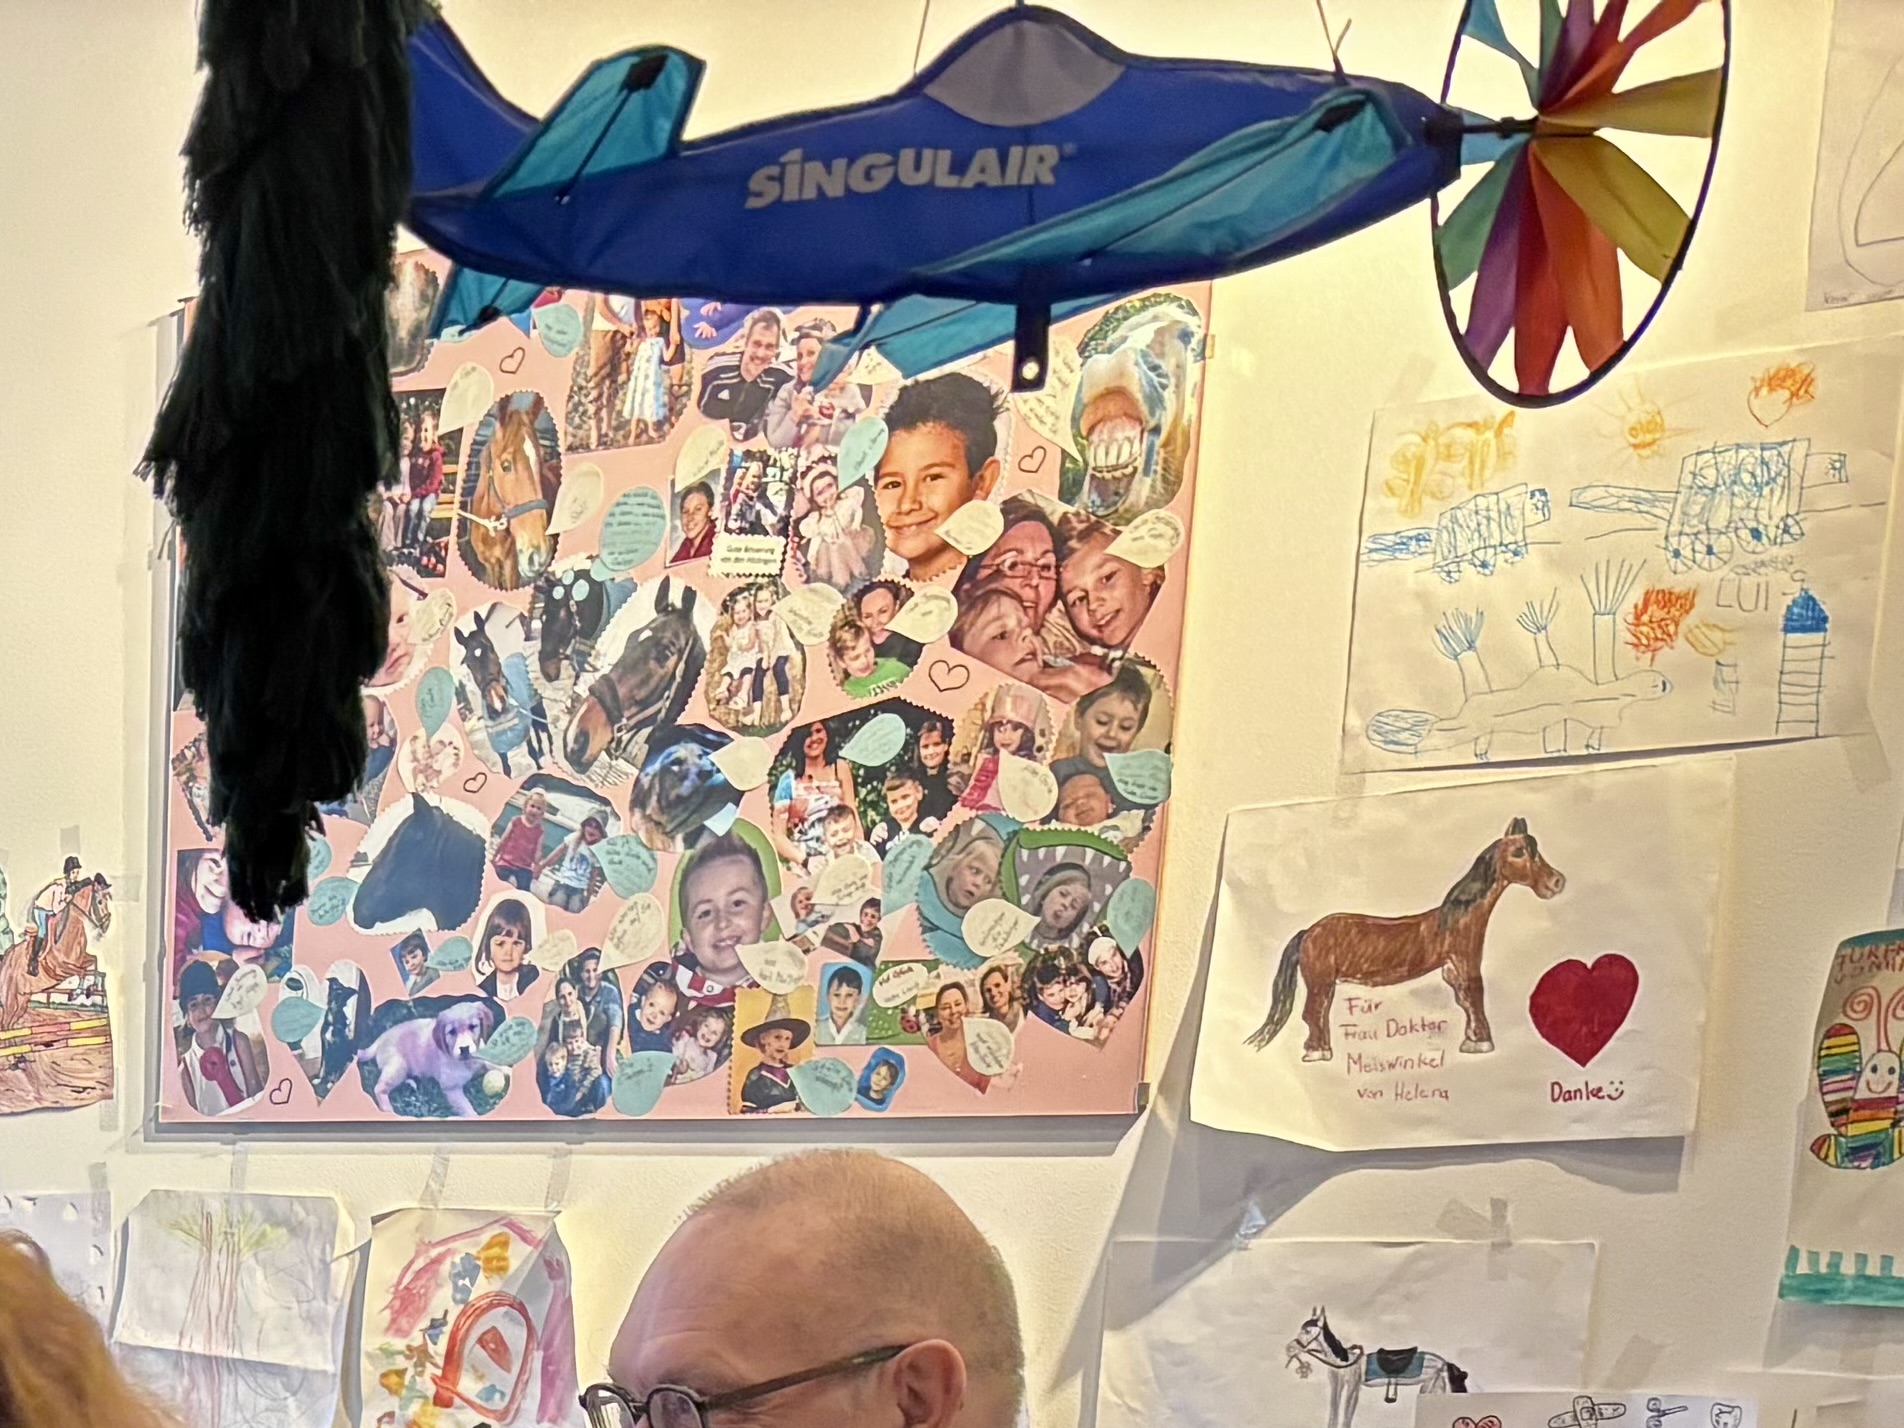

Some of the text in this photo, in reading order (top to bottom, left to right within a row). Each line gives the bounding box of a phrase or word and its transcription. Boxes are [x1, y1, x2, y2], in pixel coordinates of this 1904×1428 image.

[745, 145, 1059, 209] SINGULAIR
[1345, 998, 1383, 1016] Für
[1550, 1081, 1604, 1103] Danke
